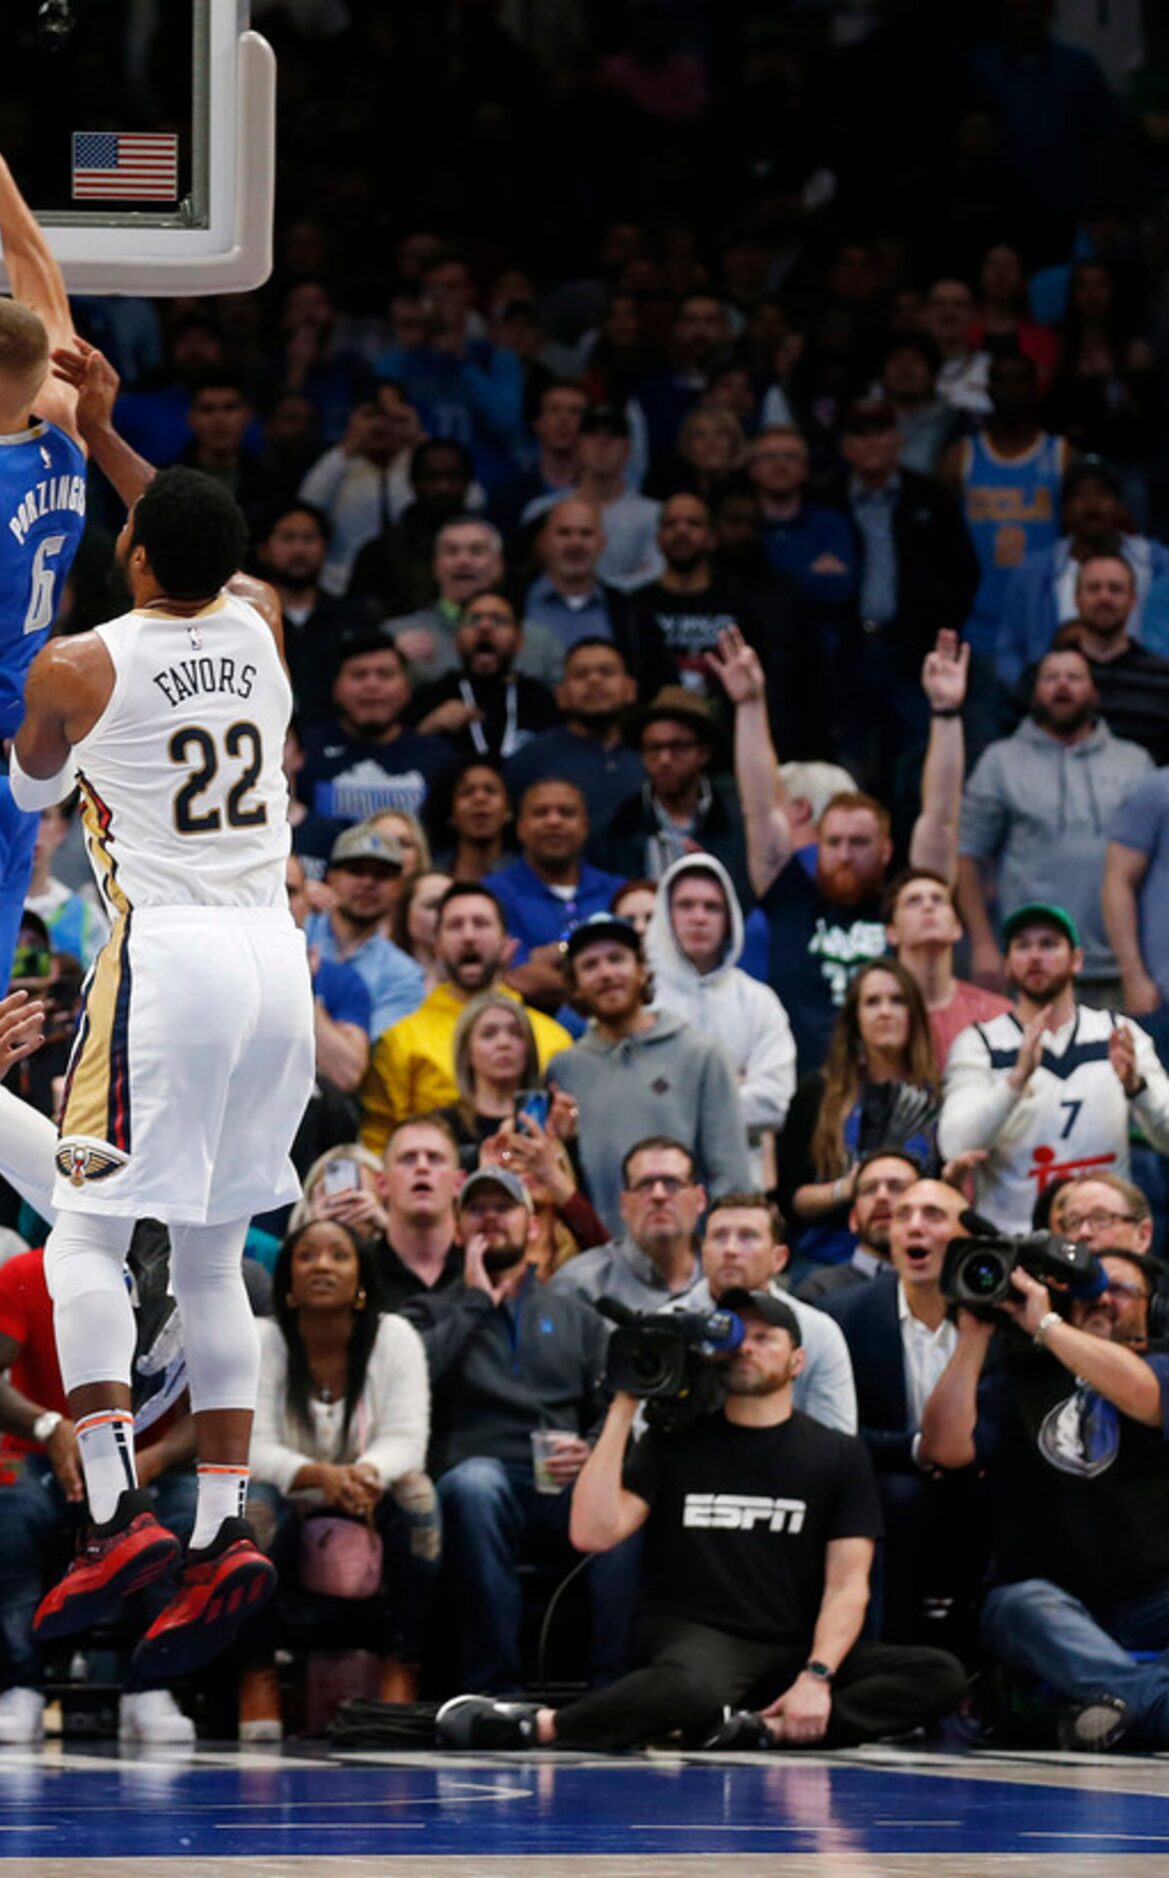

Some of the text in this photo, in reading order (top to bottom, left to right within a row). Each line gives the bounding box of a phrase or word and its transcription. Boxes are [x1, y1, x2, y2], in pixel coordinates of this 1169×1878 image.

[9, 474, 87, 546] PORZINGI
[23, 534, 66, 636] 6
[153, 656, 258, 708] FAVORS
[168, 718, 269, 837] 22
[1059, 1100, 1084, 1140] 7
[682, 1493, 808, 1535] ESPN
